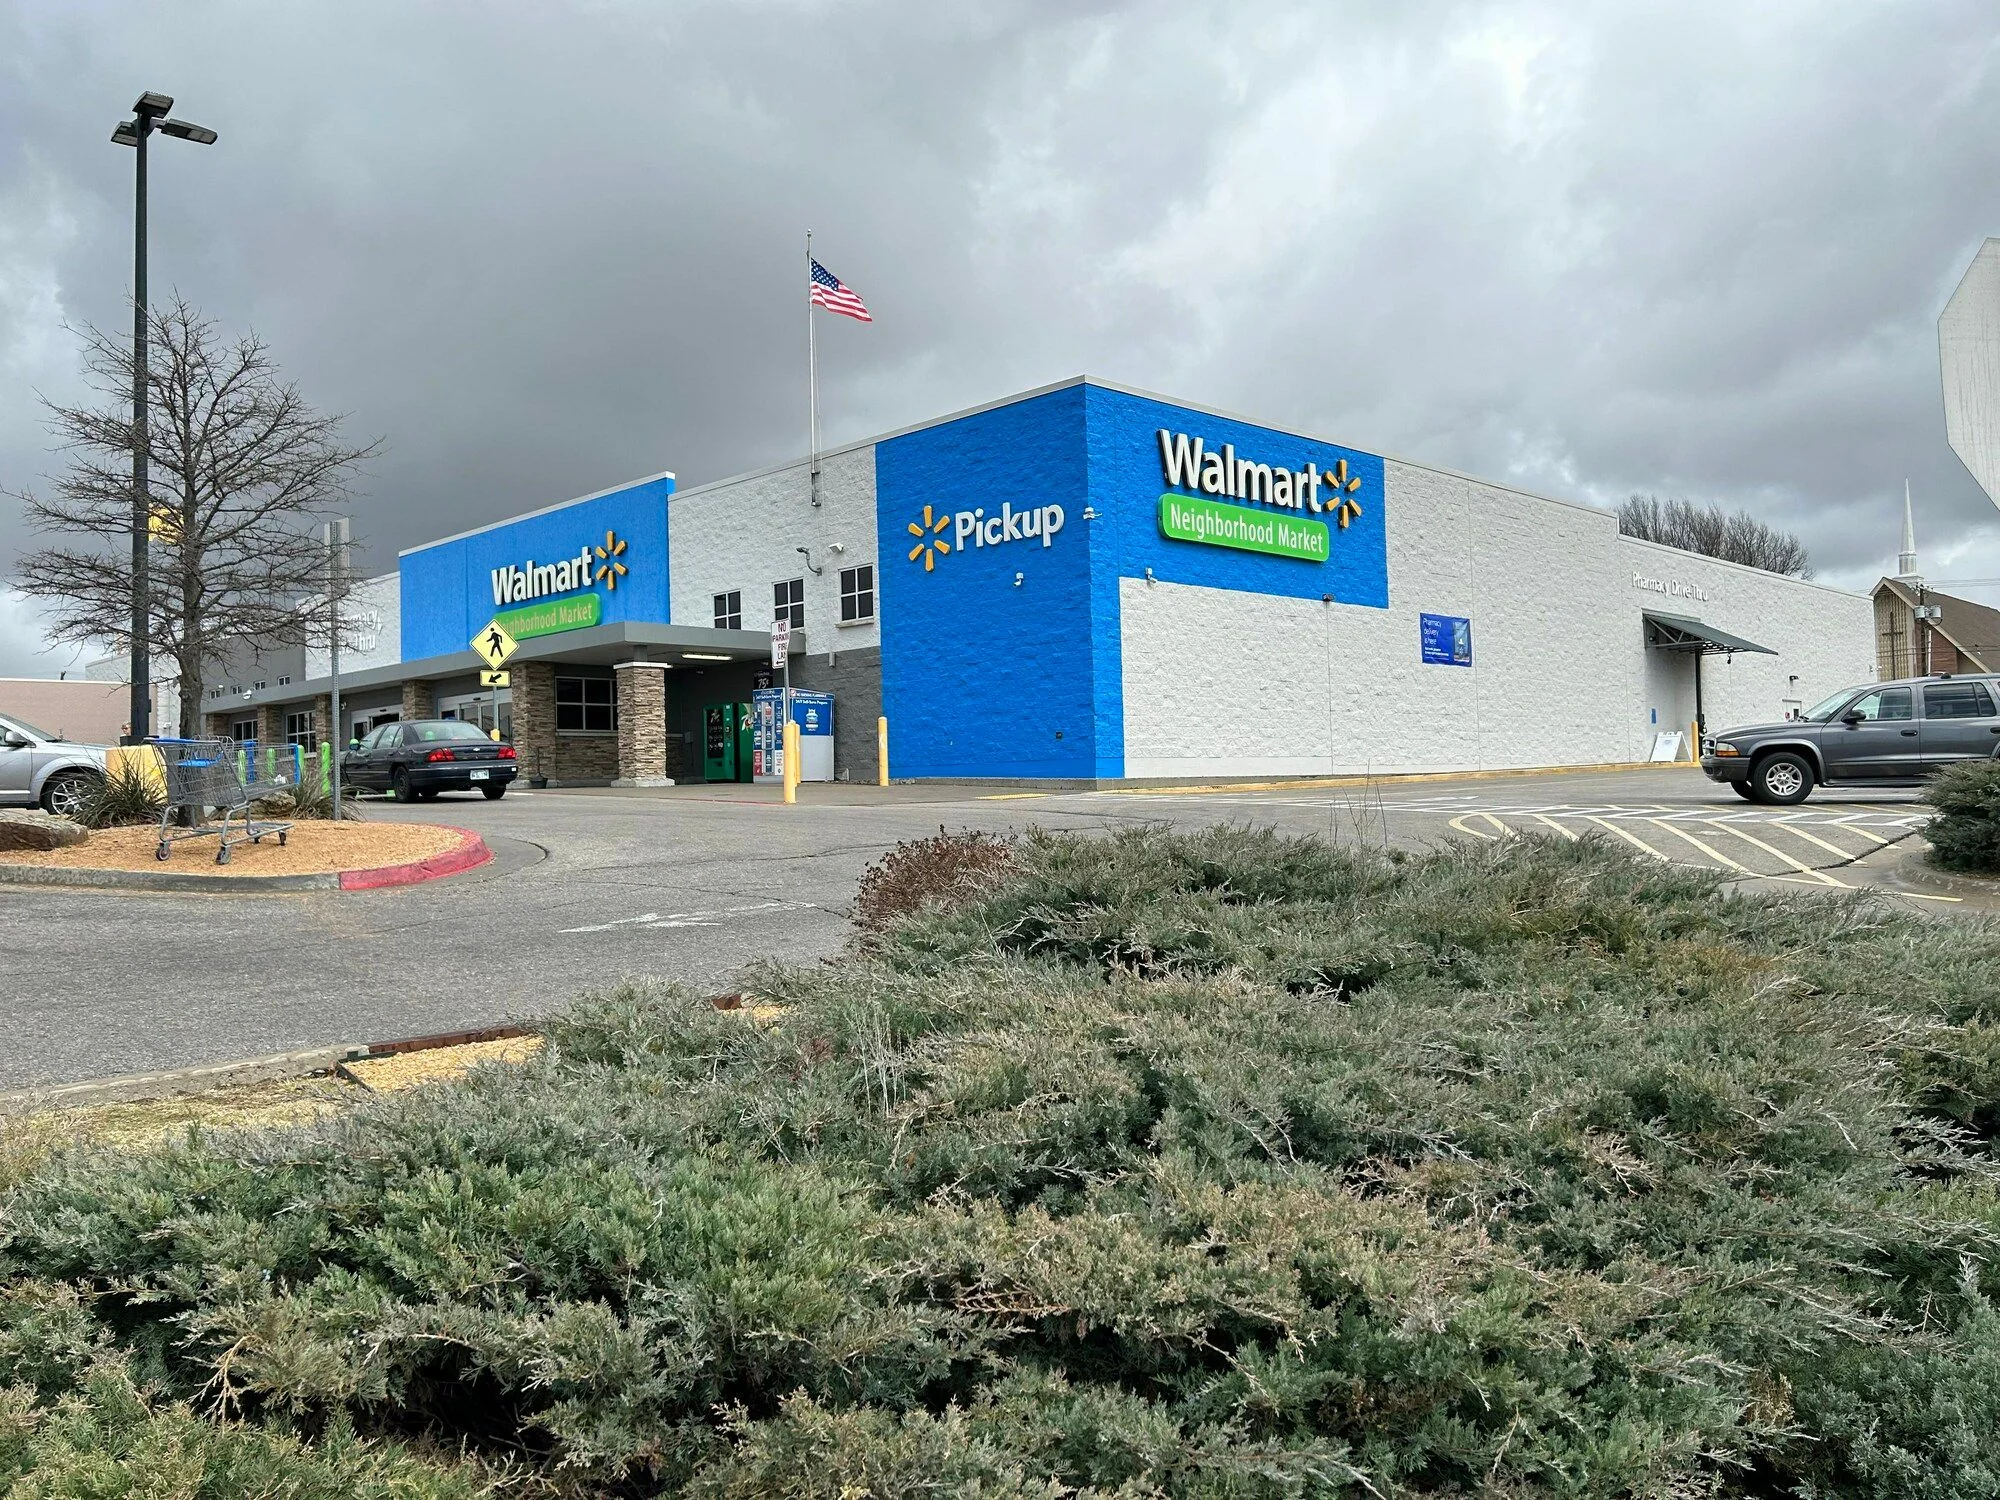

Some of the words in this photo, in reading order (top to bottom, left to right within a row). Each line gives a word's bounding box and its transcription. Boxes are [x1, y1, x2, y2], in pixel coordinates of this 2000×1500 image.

[1156, 428, 1322, 513] Walmart
[955, 502, 1064, 551] Pickup
[1170, 503, 1273, 544] Neighborhood
[1278, 523, 1323, 553] Market
[491, 546, 592, 606] Walmart
[1632, 571, 1669, 598] Pharmacy
[501, 607, 557, 635] eighborhood
[559, 602, 592, 622] Market
[777, 621, 787, 632] NO
